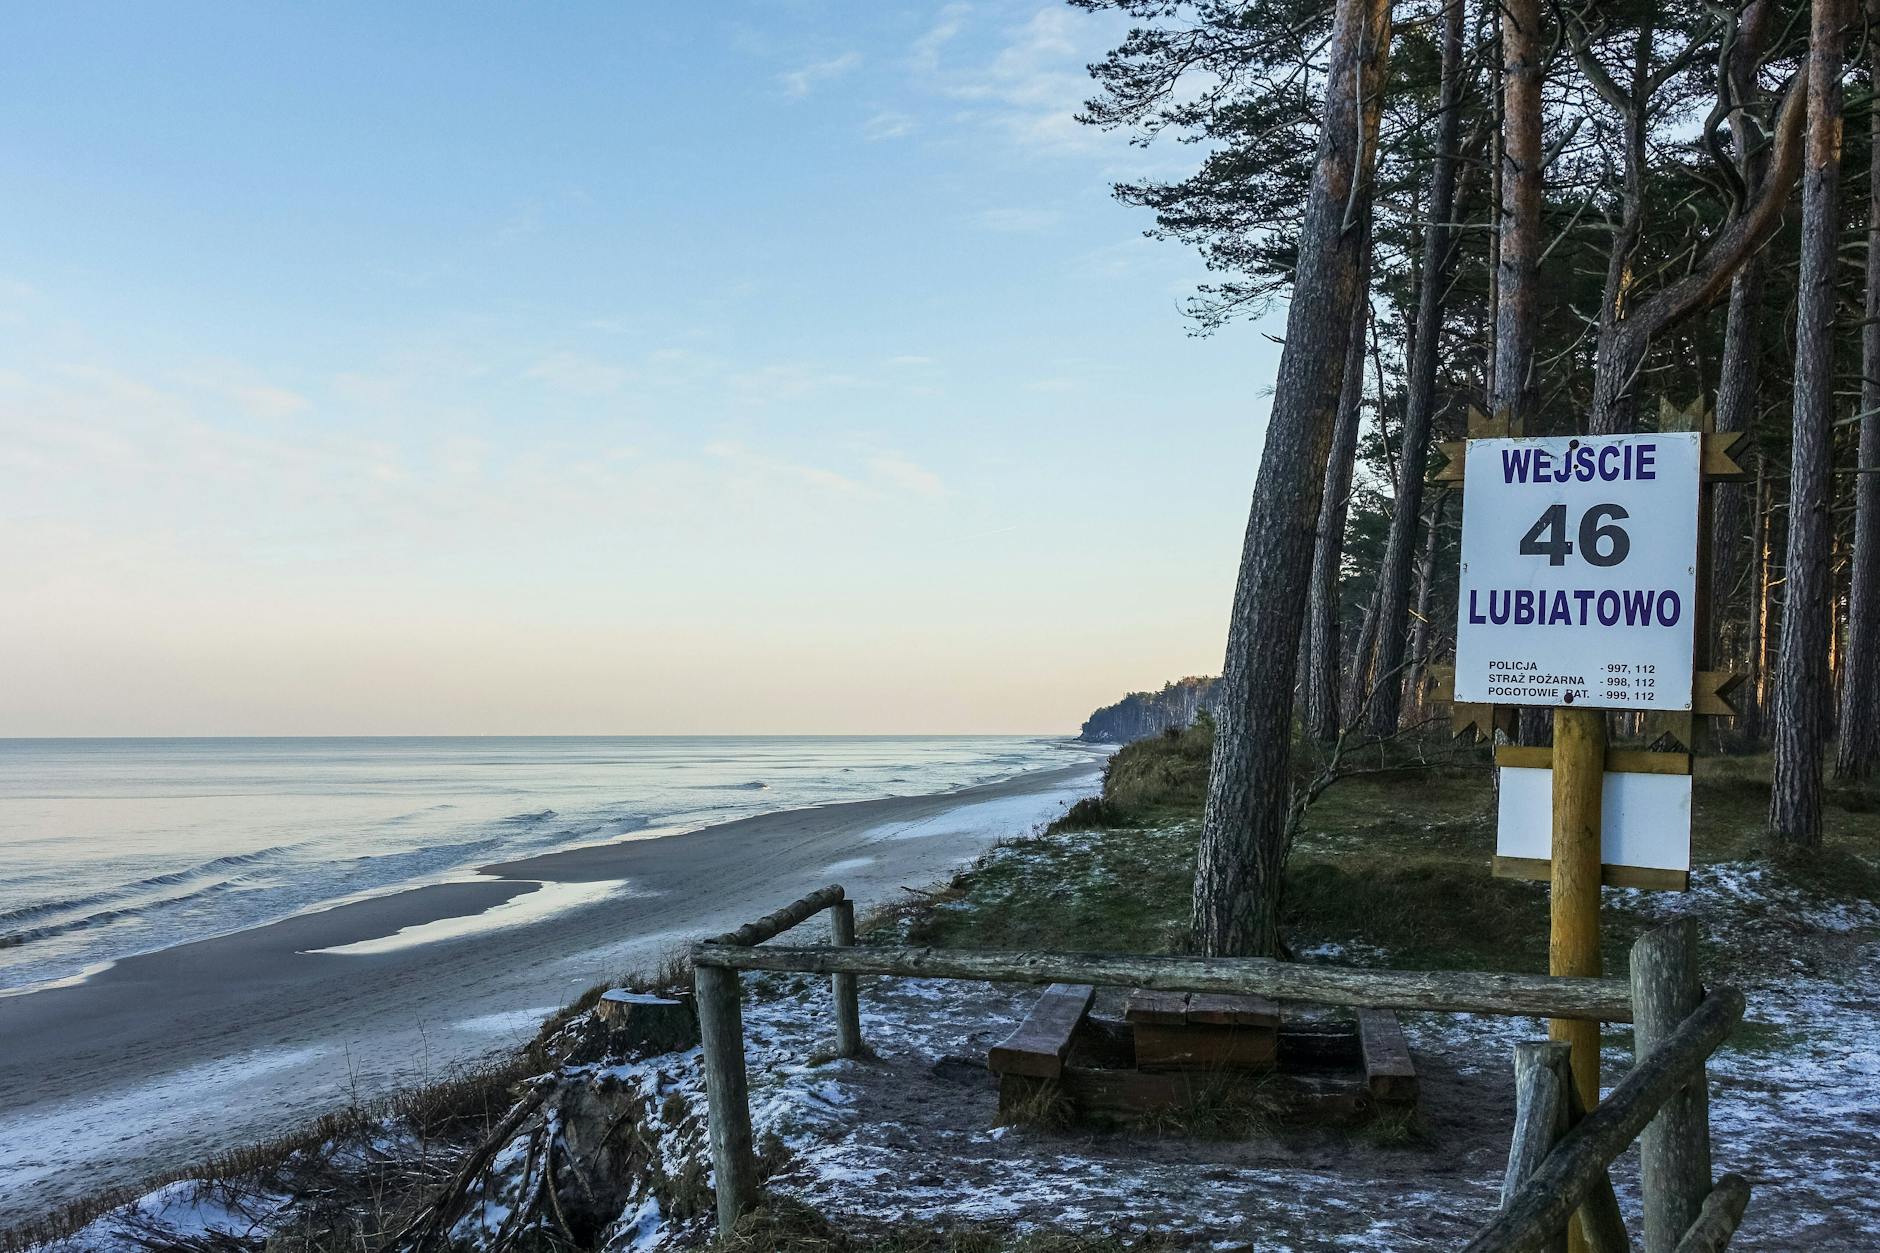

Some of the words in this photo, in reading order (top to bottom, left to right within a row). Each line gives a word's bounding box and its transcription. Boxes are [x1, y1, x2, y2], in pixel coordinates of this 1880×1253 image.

[1519, 503, 1631, 567] 46
[1469, 590, 1681, 627] LUBIATOWO
[1489, 661, 1538, 671] POLICJA
[1607, 664, 1631, 674] 997,
[1635, 665, 1655, 674] 112
[1488, 673, 1526, 683] STRAŻ
[1528, 673, 1585, 685] POŻARNA
[1607, 677, 1631, 688] 998,
[1635, 679, 1655, 687] 112
[1488, 687, 1559, 697] POGOTOWIE
[1606, 691, 1630, 701] 999,
[1634, 692, 1655, 701] 112
